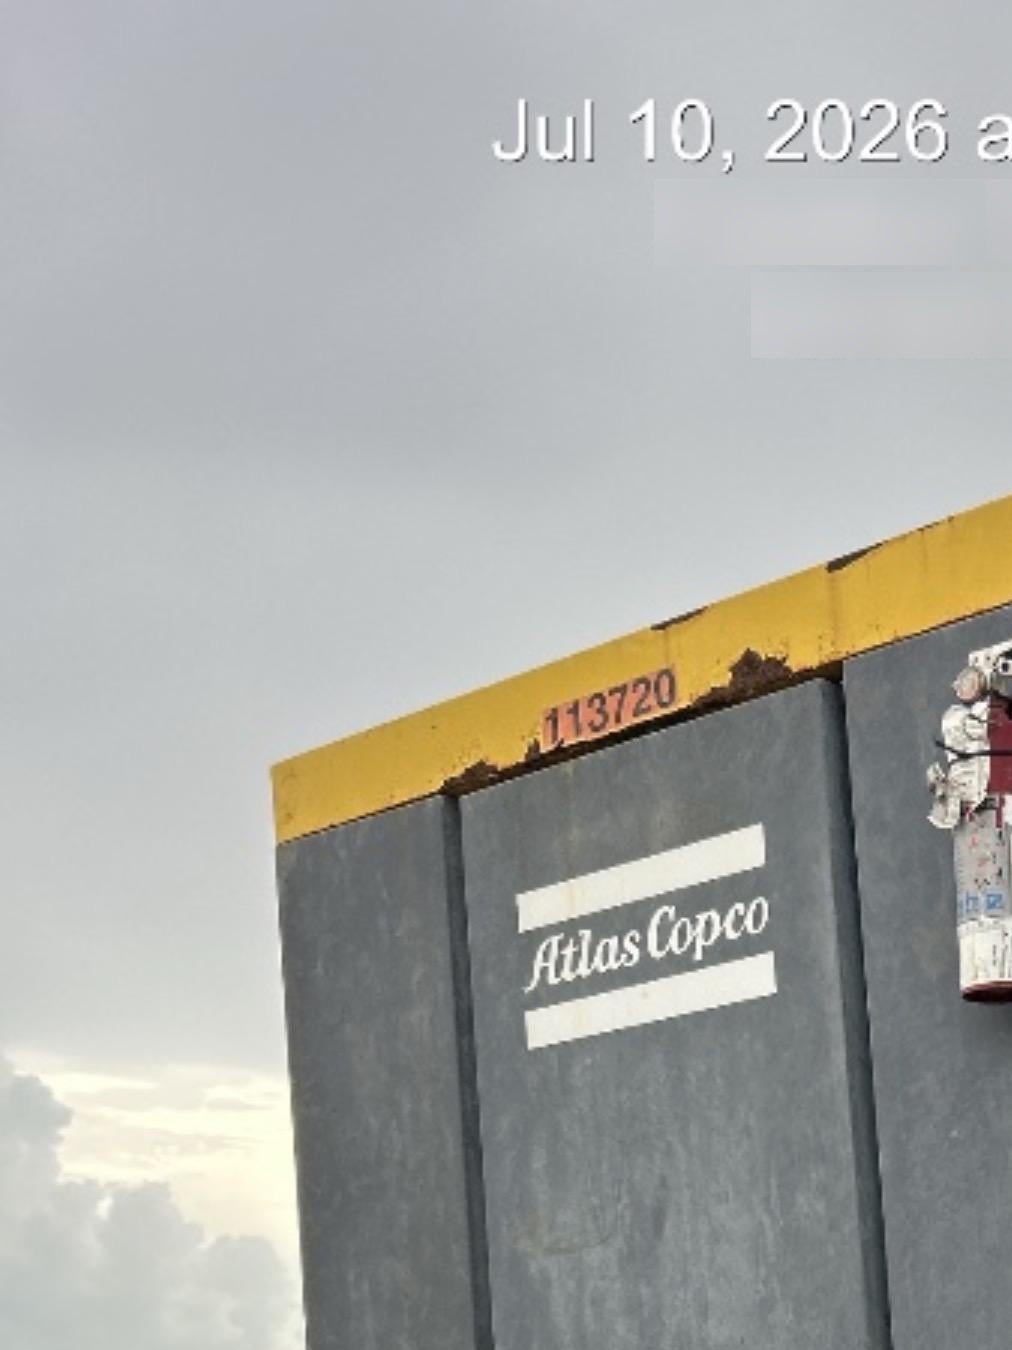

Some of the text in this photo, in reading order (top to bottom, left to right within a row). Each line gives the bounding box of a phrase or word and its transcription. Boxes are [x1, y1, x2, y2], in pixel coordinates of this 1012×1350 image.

[544, 667, 676, 745] 113720
[523, 896, 769, 994] Atlas Copco
